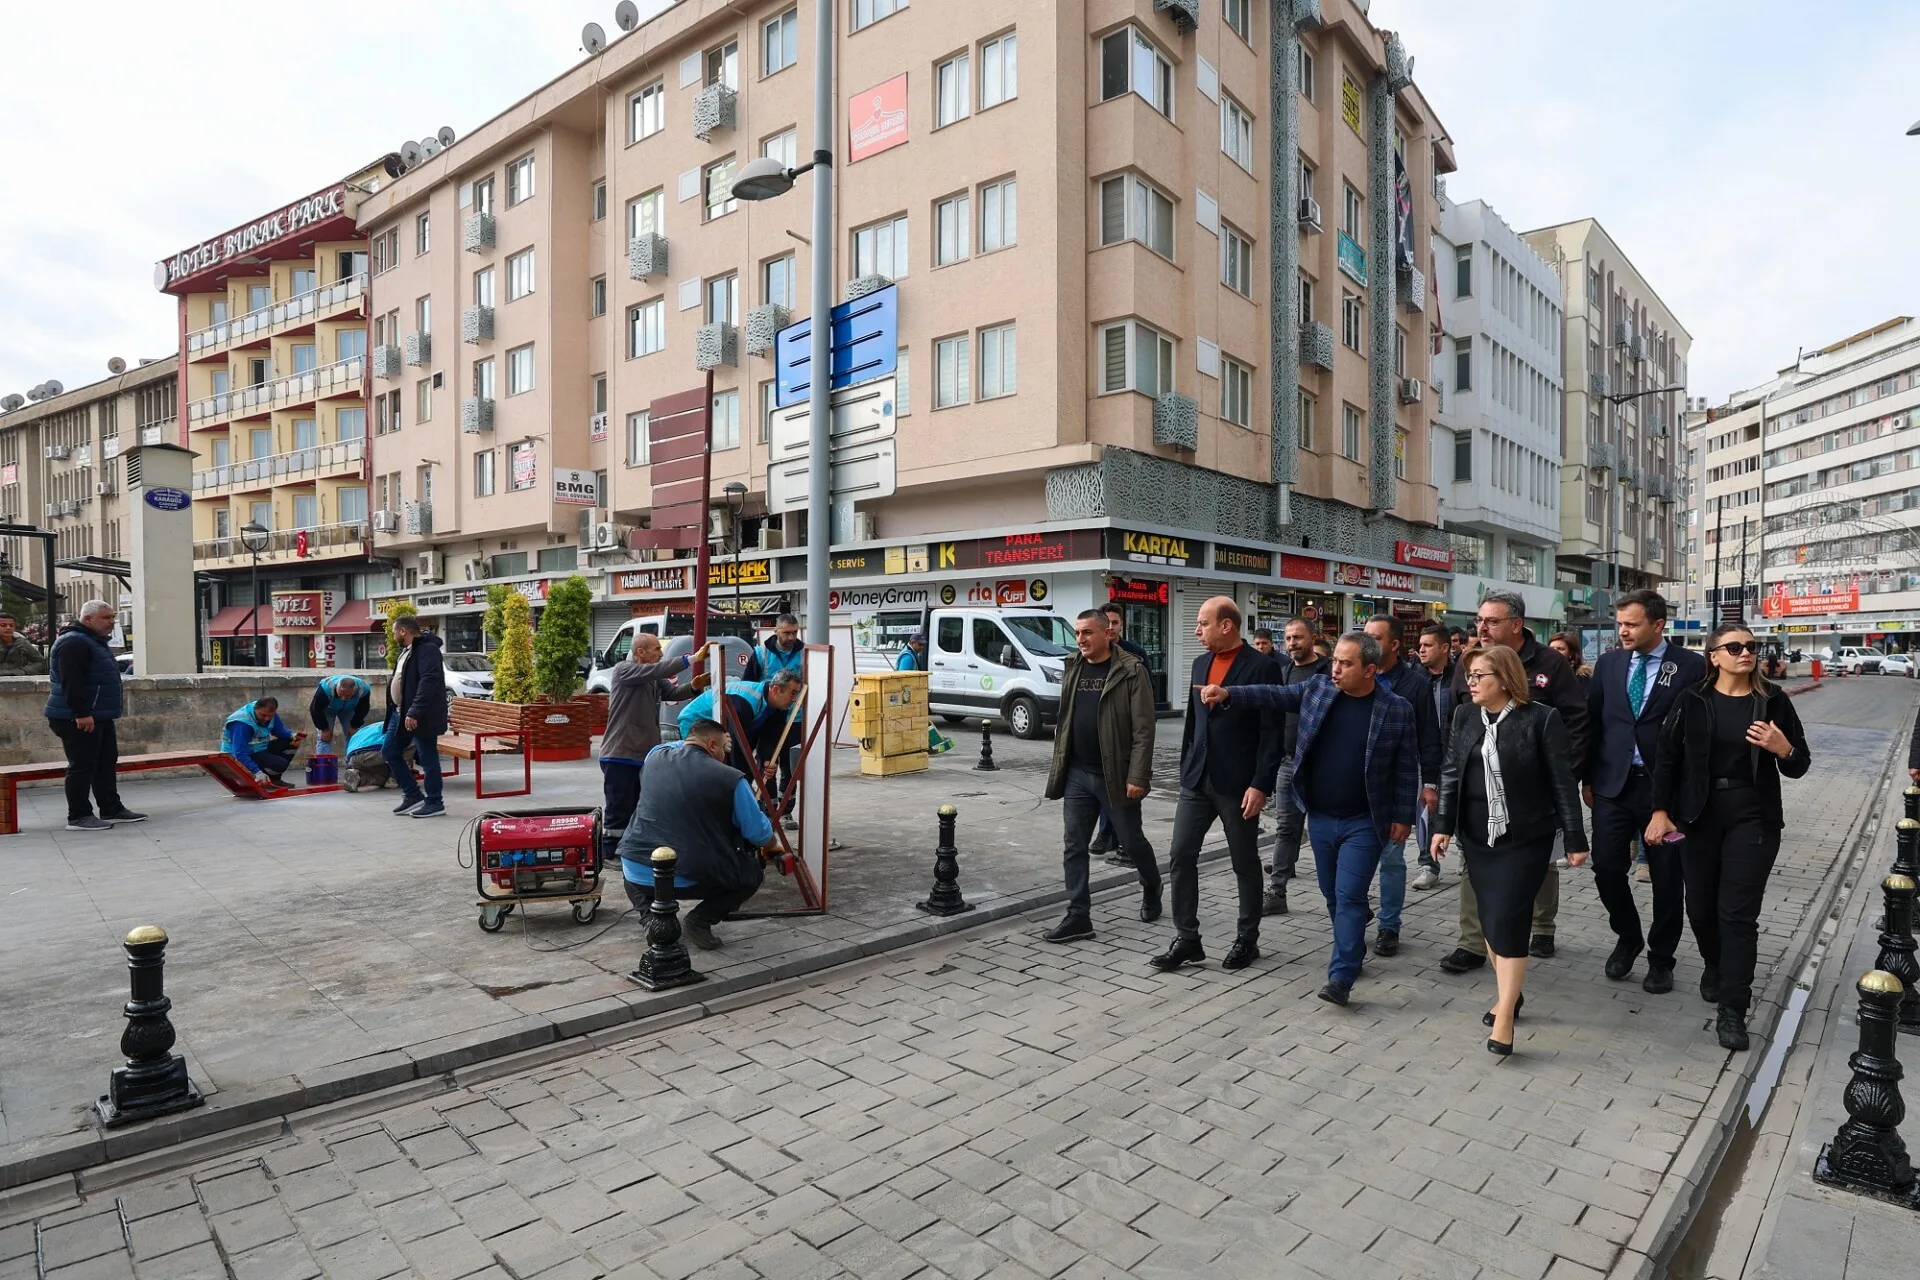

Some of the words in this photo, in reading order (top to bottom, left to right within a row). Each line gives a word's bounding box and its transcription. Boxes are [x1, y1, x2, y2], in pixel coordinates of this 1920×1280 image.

[168, 240, 221, 281] HOTEL
[223, 214, 284, 258] BURAK
[286, 188, 341, 232] PARK
[556, 481, 595, 494] BMG
[1006, 532, 1043, 547] PARA
[1123, 532, 1190, 559] KARTAL
[837, 556, 866, 569] SERVİS
[986, 543, 1064, 564] TRANSFERİ
[1228, 549, 1269, 570] ELEKTRONİK
[620, 571, 650, 589] YAĞMUR
[841, 588, 928, 608] MoneyGram
[968, 581, 992, 601] ria
[1005, 592, 1025, 603] UPT
[324, 592, 332, 616] HOTEL
[325, 636, 336, 667] HOTE
[551, 817, 579, 825] ER9500
